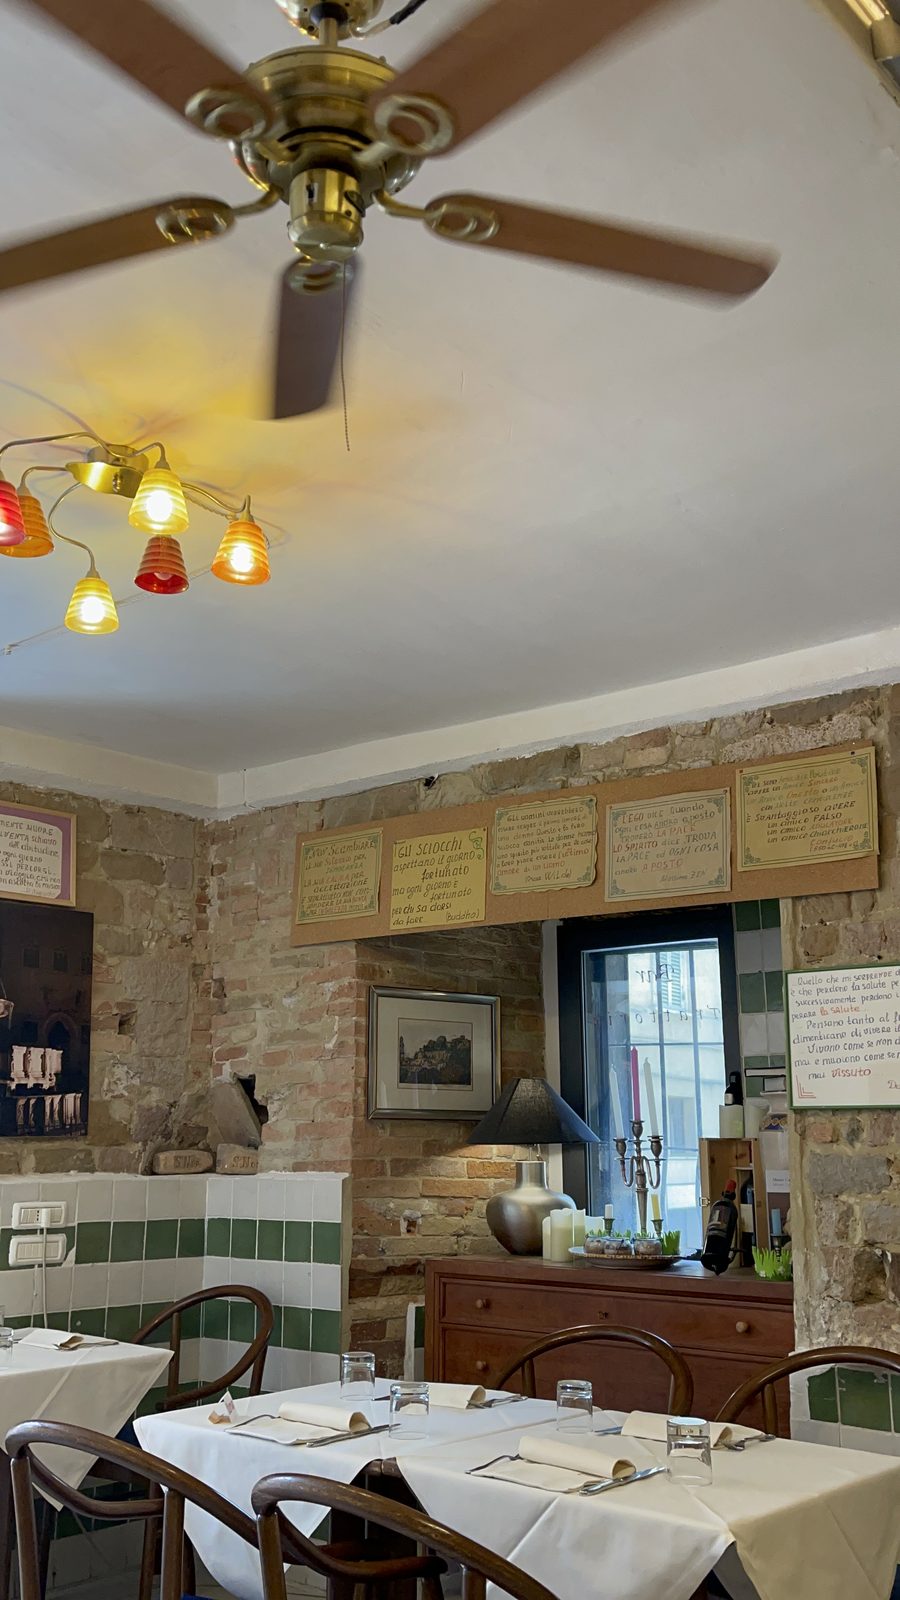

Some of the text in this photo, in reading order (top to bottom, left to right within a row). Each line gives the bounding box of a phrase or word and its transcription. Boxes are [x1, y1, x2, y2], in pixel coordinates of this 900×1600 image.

[813, 811, 843, 823] FALSO
[796, 975, 823, 986] Quello
[826, 975, 839, 984] che
[798, 987, 813, 997] che
[847, 1013, 875, 1026] tanto
[792, 1030, 848, 1046] dimenticano
[843, 1042, 865, 1052] come
